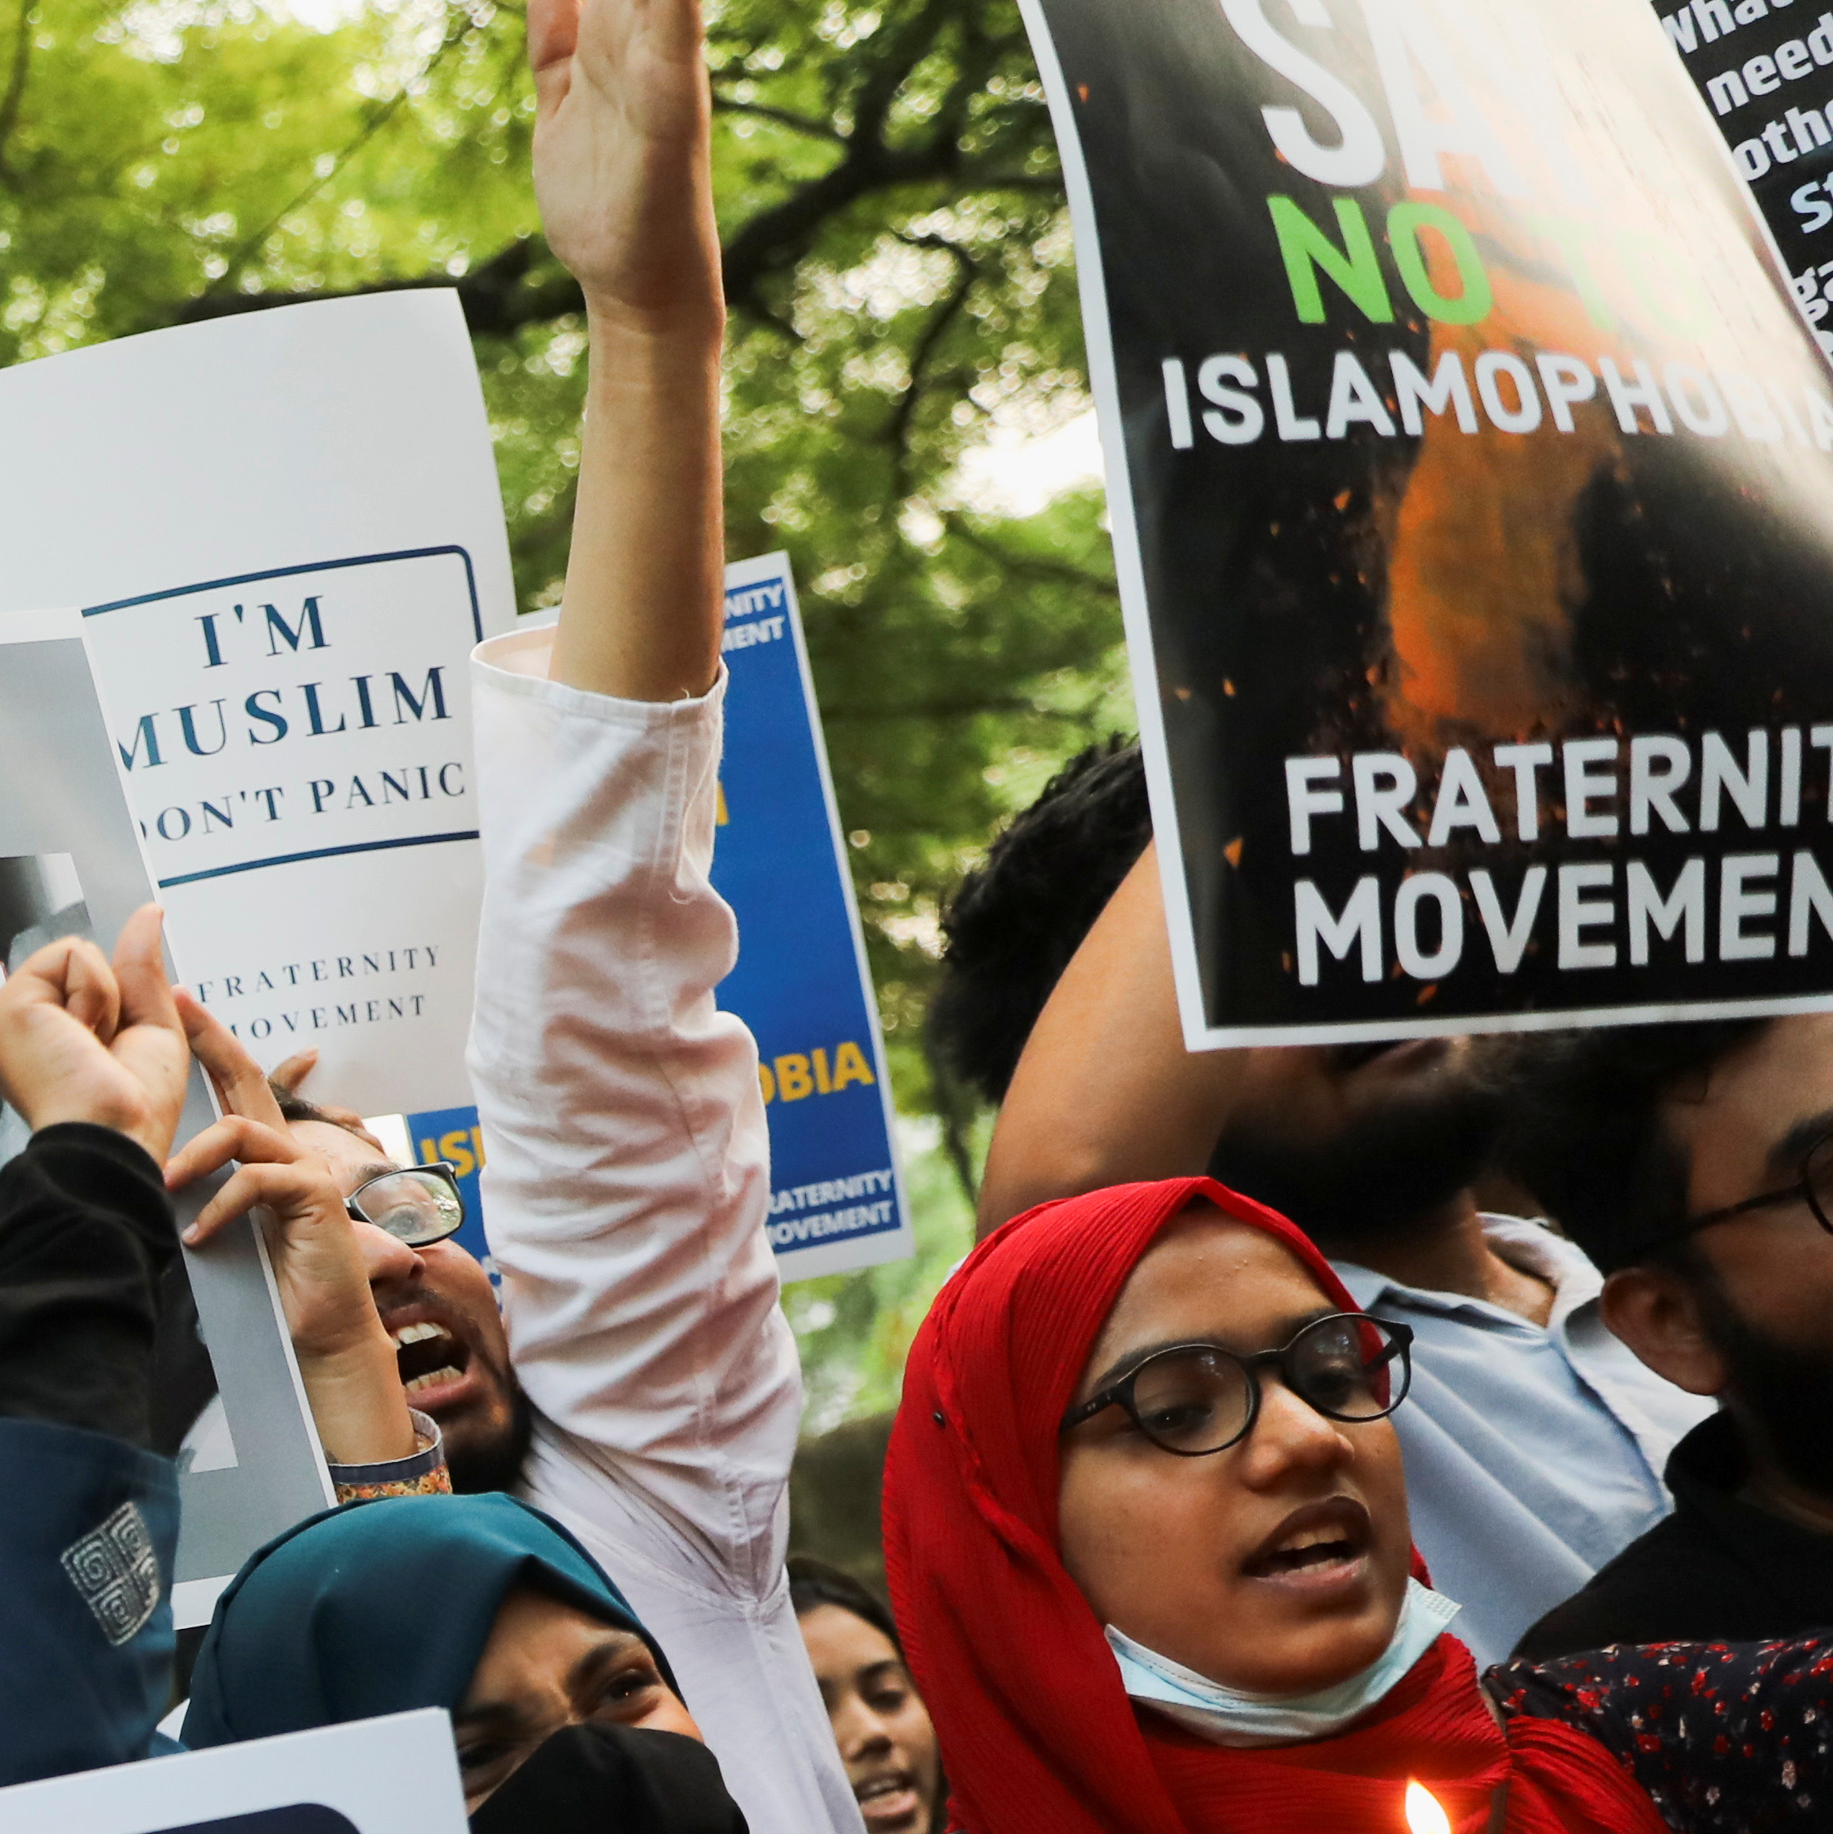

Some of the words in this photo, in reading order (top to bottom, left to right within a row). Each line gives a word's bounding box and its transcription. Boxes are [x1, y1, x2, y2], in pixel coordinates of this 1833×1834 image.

[1221, 0, 1598, 200] SA
[1266, 194, 1493, 325] NO
[194, 595, 332, 669] I'M
[117, 666, 452, 772] MUSLIM
[139, 787, 285, 842] ON'T
[307, 762, 466, 815] PANIC
[197, 945, 440, 1004] FRATERNITY
